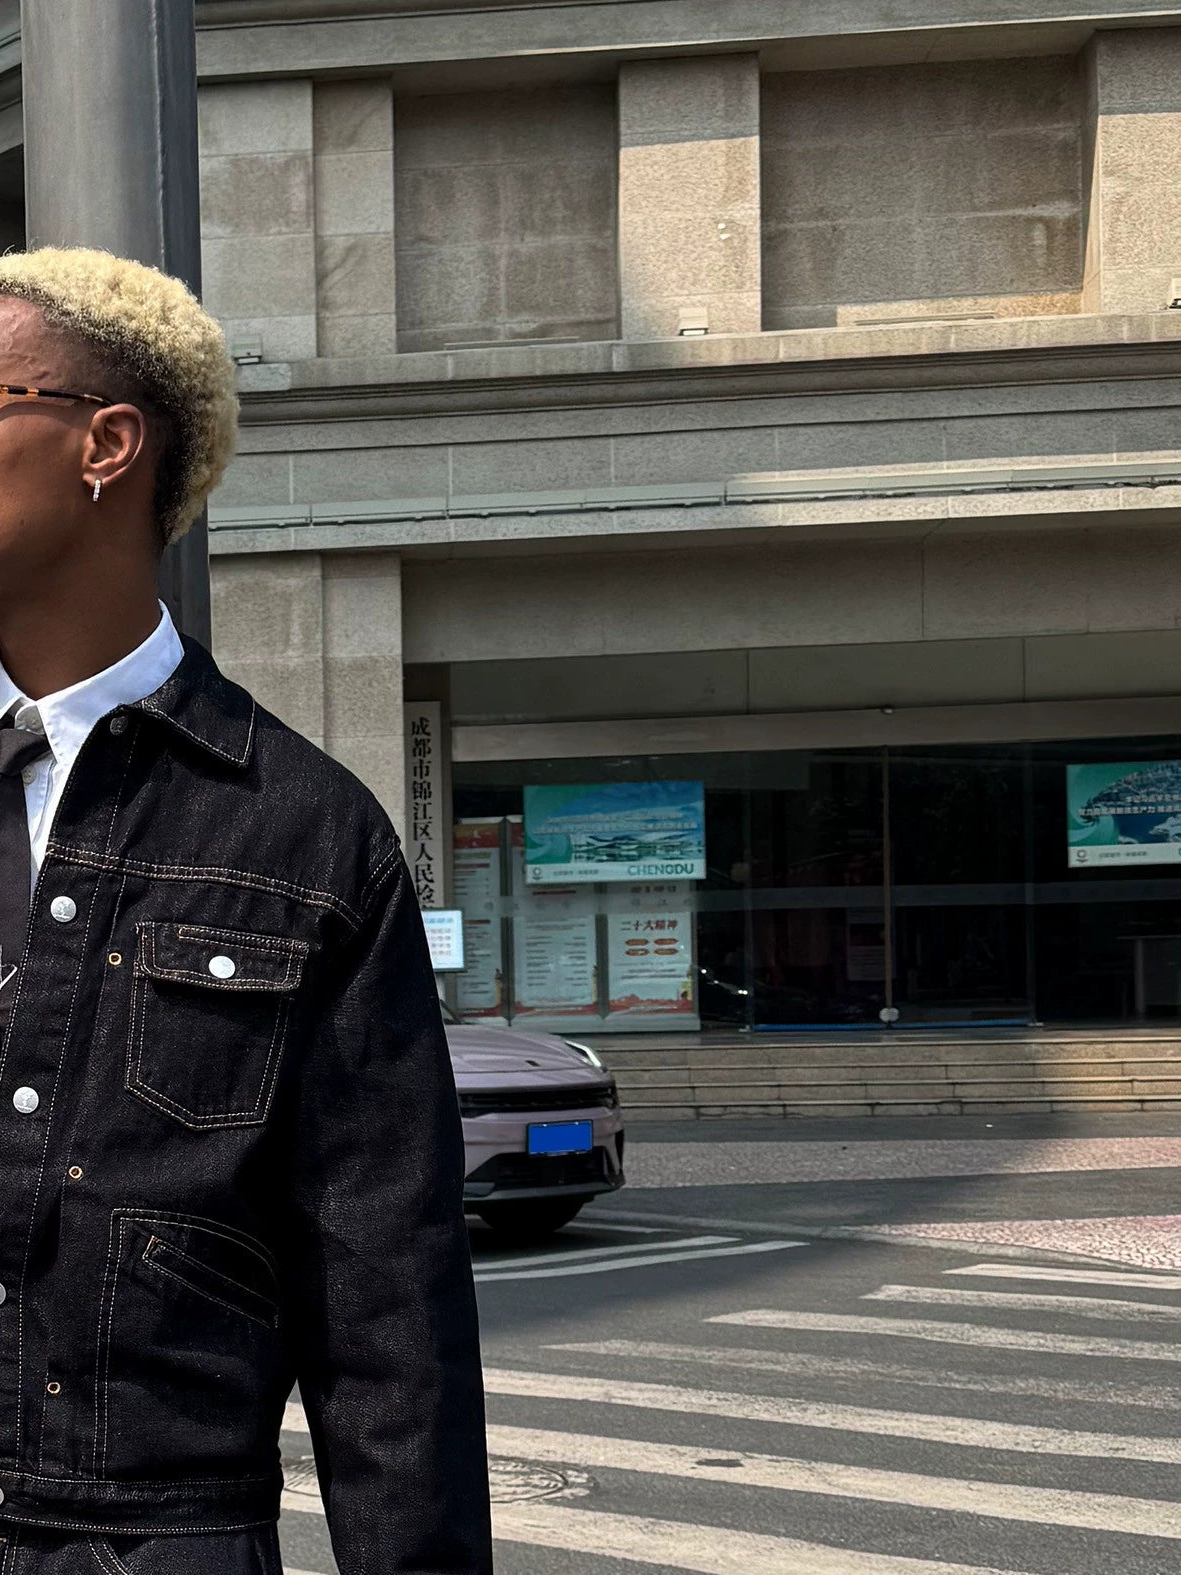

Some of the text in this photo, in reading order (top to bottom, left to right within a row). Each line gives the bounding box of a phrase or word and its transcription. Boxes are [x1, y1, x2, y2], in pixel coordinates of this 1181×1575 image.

[411, 716, 435, 908] 成都市锦江区人民检
[627, 862, 695, 877] CHENGDU
